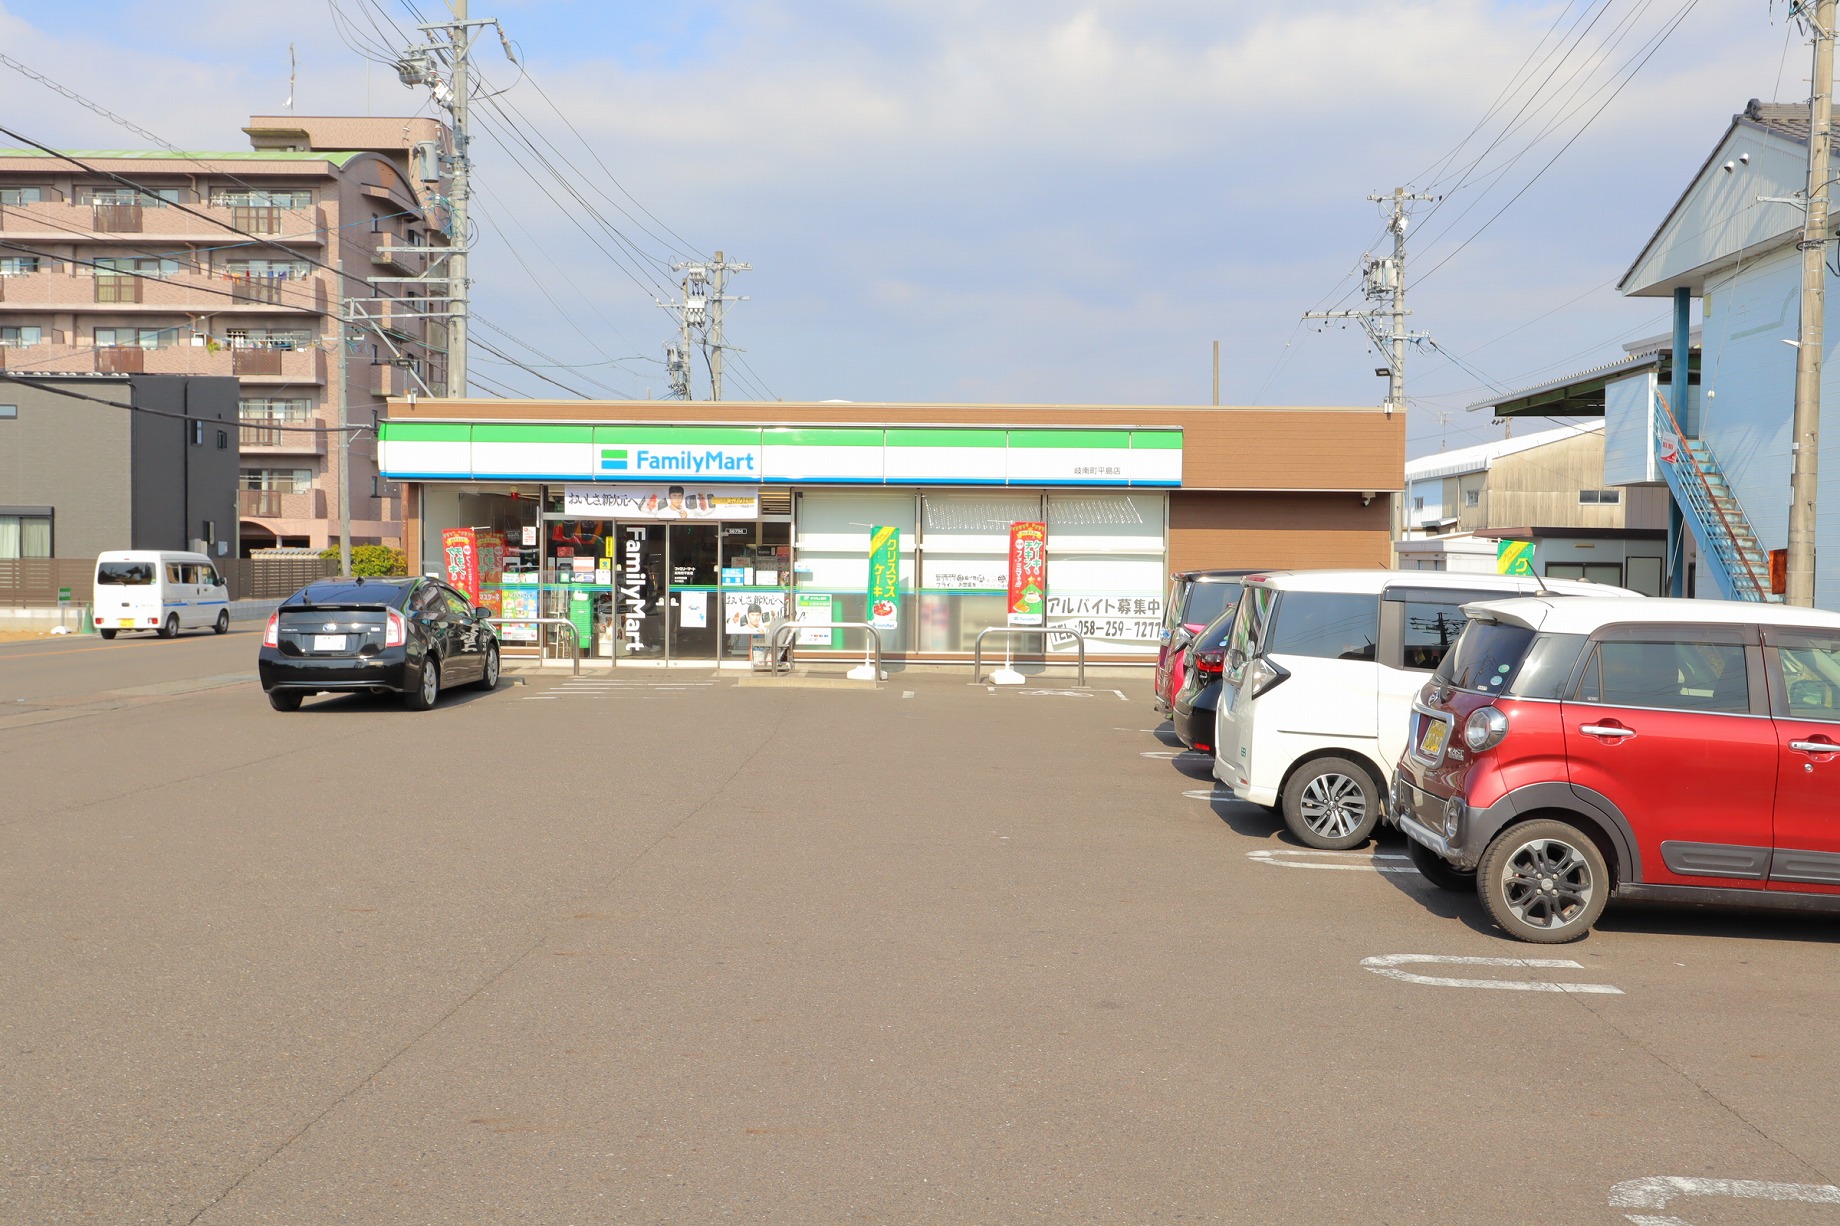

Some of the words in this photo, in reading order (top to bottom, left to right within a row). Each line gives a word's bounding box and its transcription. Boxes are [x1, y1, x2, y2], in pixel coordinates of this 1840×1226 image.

[637, 450, 754, 473] FamilyMart
[1074, 466, 1121, 475] 岐南町平島店
[568, 492, 640, 507] おいしさ新次元へ
[884, 539, 897, 598] クリスマス
[1515, 557, 1528, 576] ク
[620, 527, 646, 651] FamilyMart
[873, 564, 885, 597] ケーキ
[726, 594, 784, 606] おいしさ新次元へ
[1047, 597, 1160, 616] アルバイト募集中
